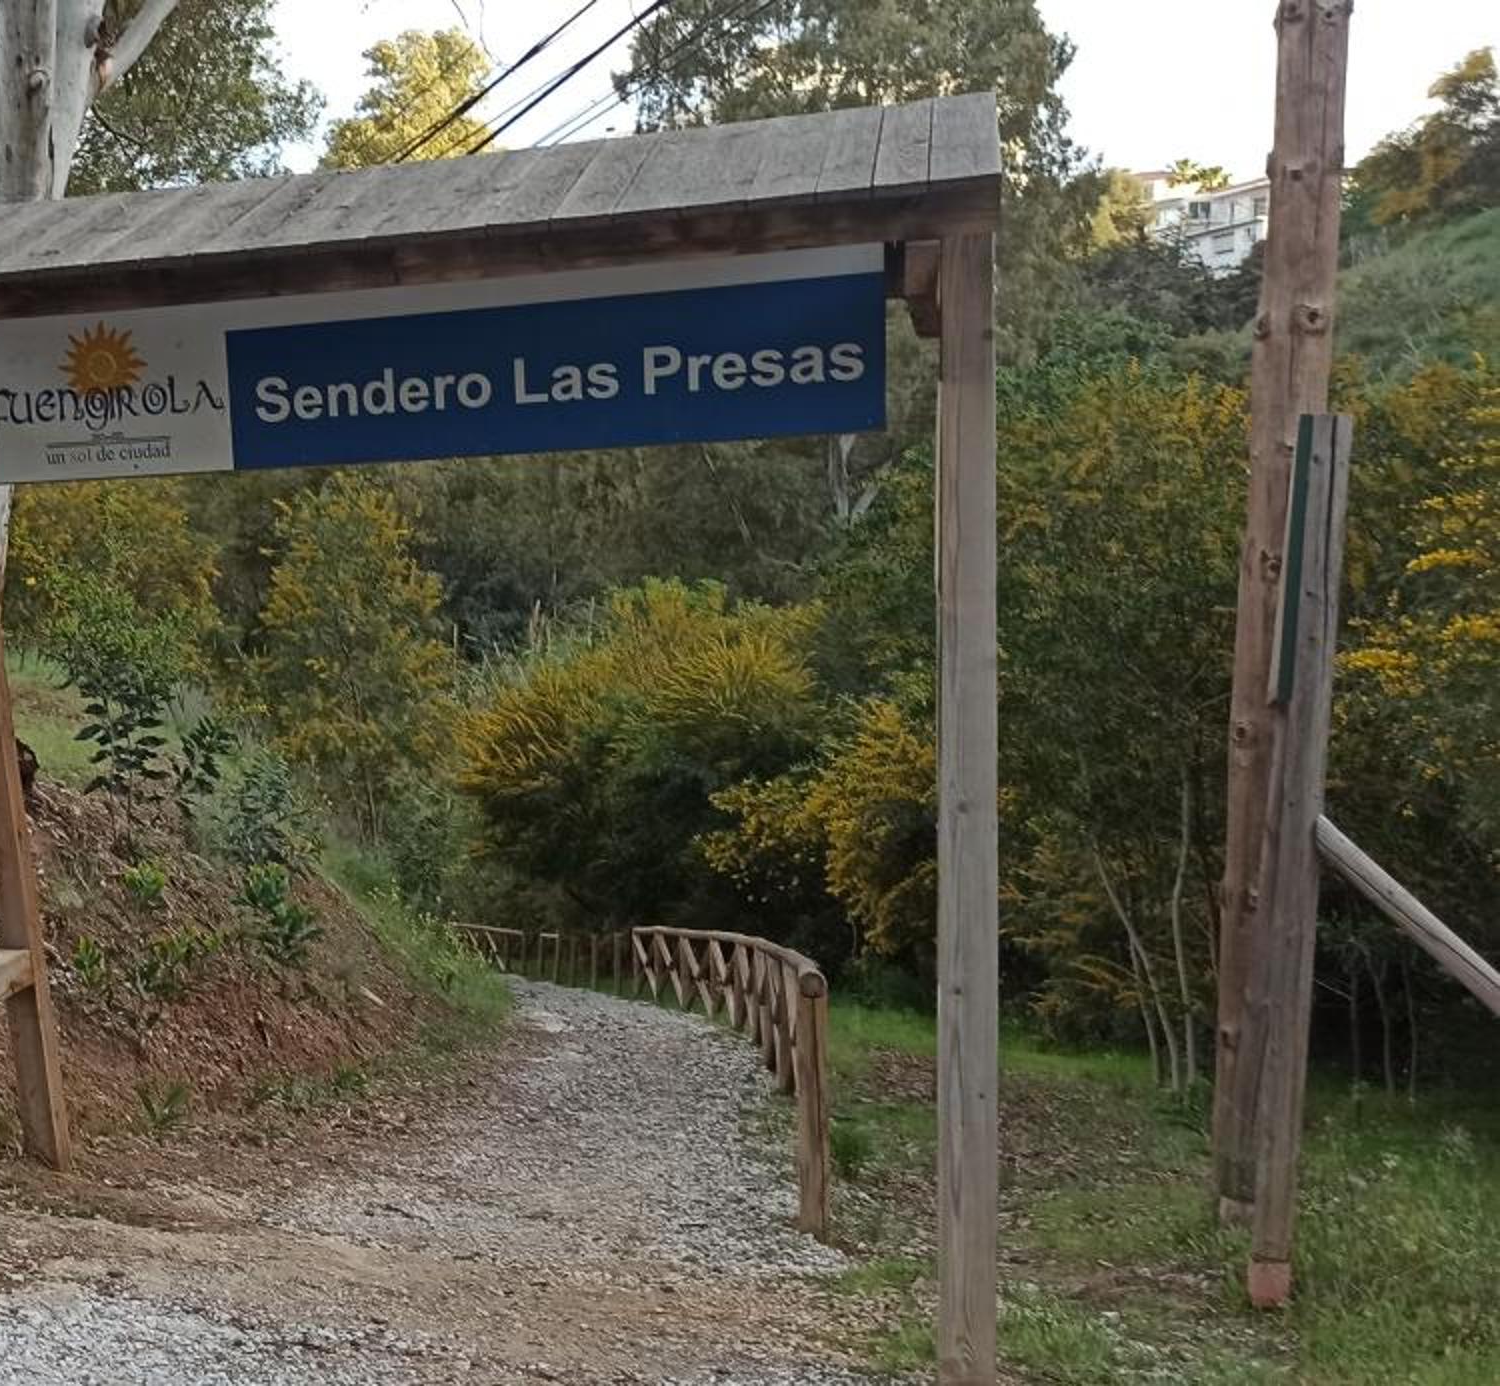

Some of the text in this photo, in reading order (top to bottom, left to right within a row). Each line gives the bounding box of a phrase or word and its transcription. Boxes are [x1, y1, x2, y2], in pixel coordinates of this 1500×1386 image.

[254, 341, 866, 423] Sendero Las Presas
[46, 439, 171, 464] un sol de ciudad
